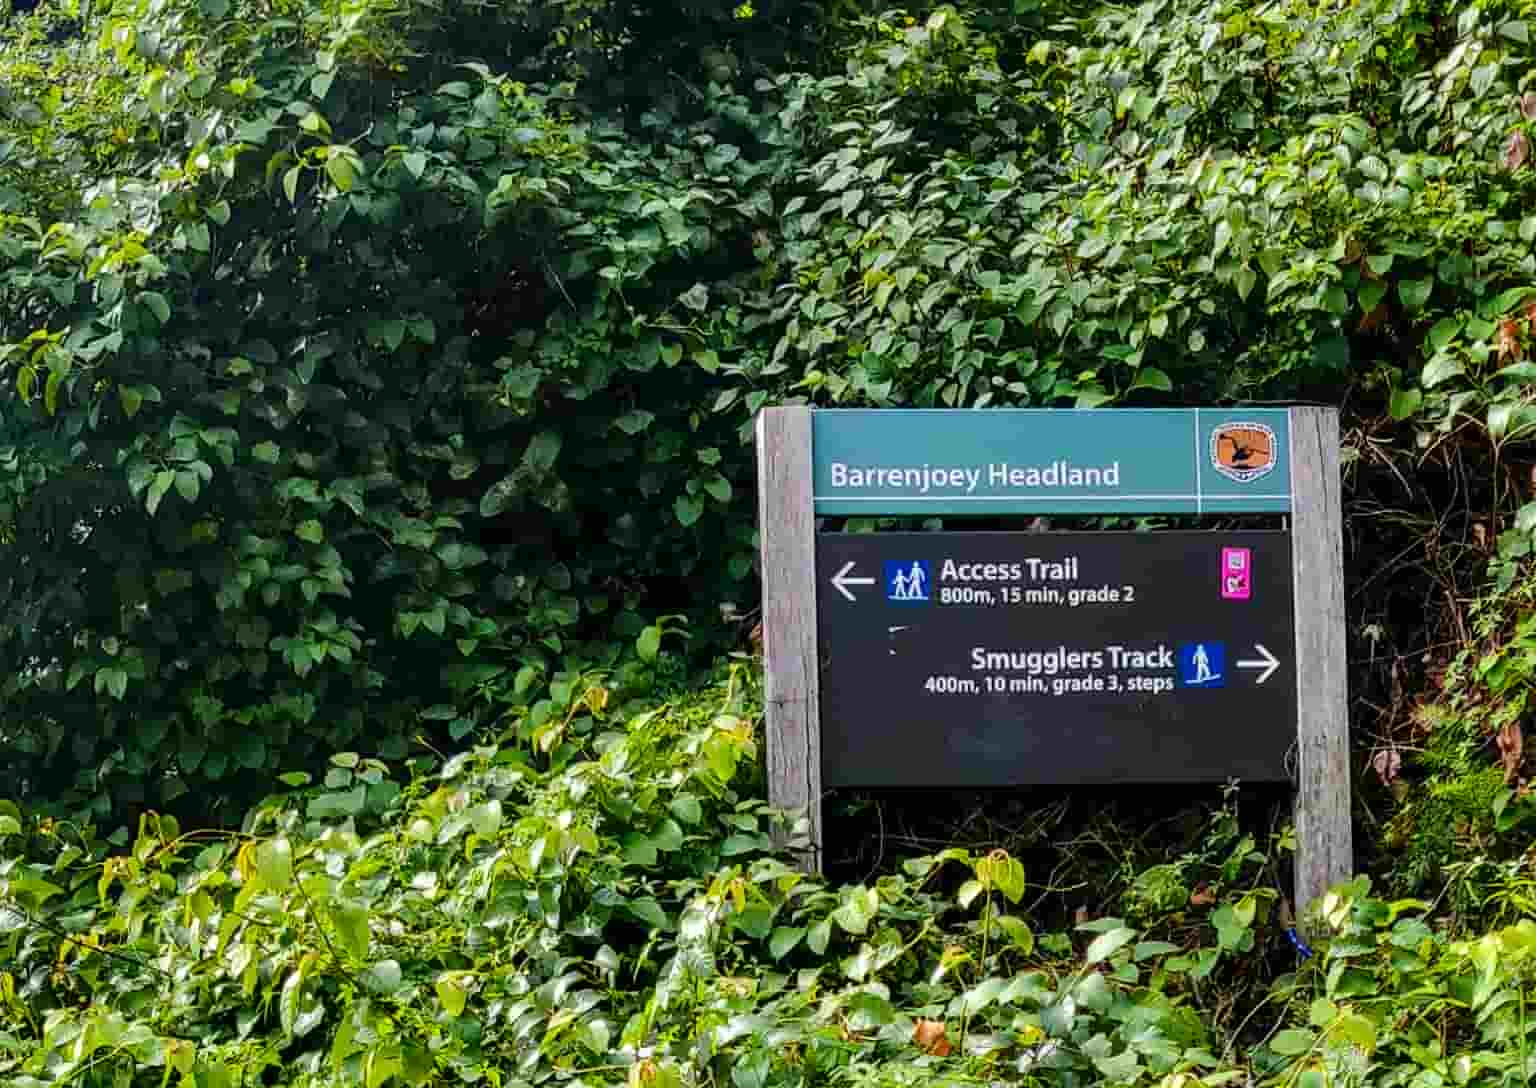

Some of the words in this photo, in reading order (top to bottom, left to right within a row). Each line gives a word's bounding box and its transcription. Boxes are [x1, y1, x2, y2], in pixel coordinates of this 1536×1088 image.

[830, 463, 980, 492] Barrenjoey
[990, 463, 1120, 486] Headland
[940, 558, 1022, 582] Access
[1025, 556, 1079, 581] Trail
[940, 587, 996, 605] 800m,
[1000, 587, 1022, 603] 15
[1025, 586, 1065, 604] min,
[1067, 584, 1120, 606] grade
[1123, 585, 1136, 602] 2
[971, 645, 1104, 675] Smugglers
[1106, 644, 1175, 669] Track
[924, 676, 980, 695] 400m,
[984, 676, 1006, 693] 10
[1009, 676, 1049, 694] min,
[1052, 674, 1105, 696] grade
[1107, 674, 1124, 693] 3,
[1127, 675, 1175, 695] steps
